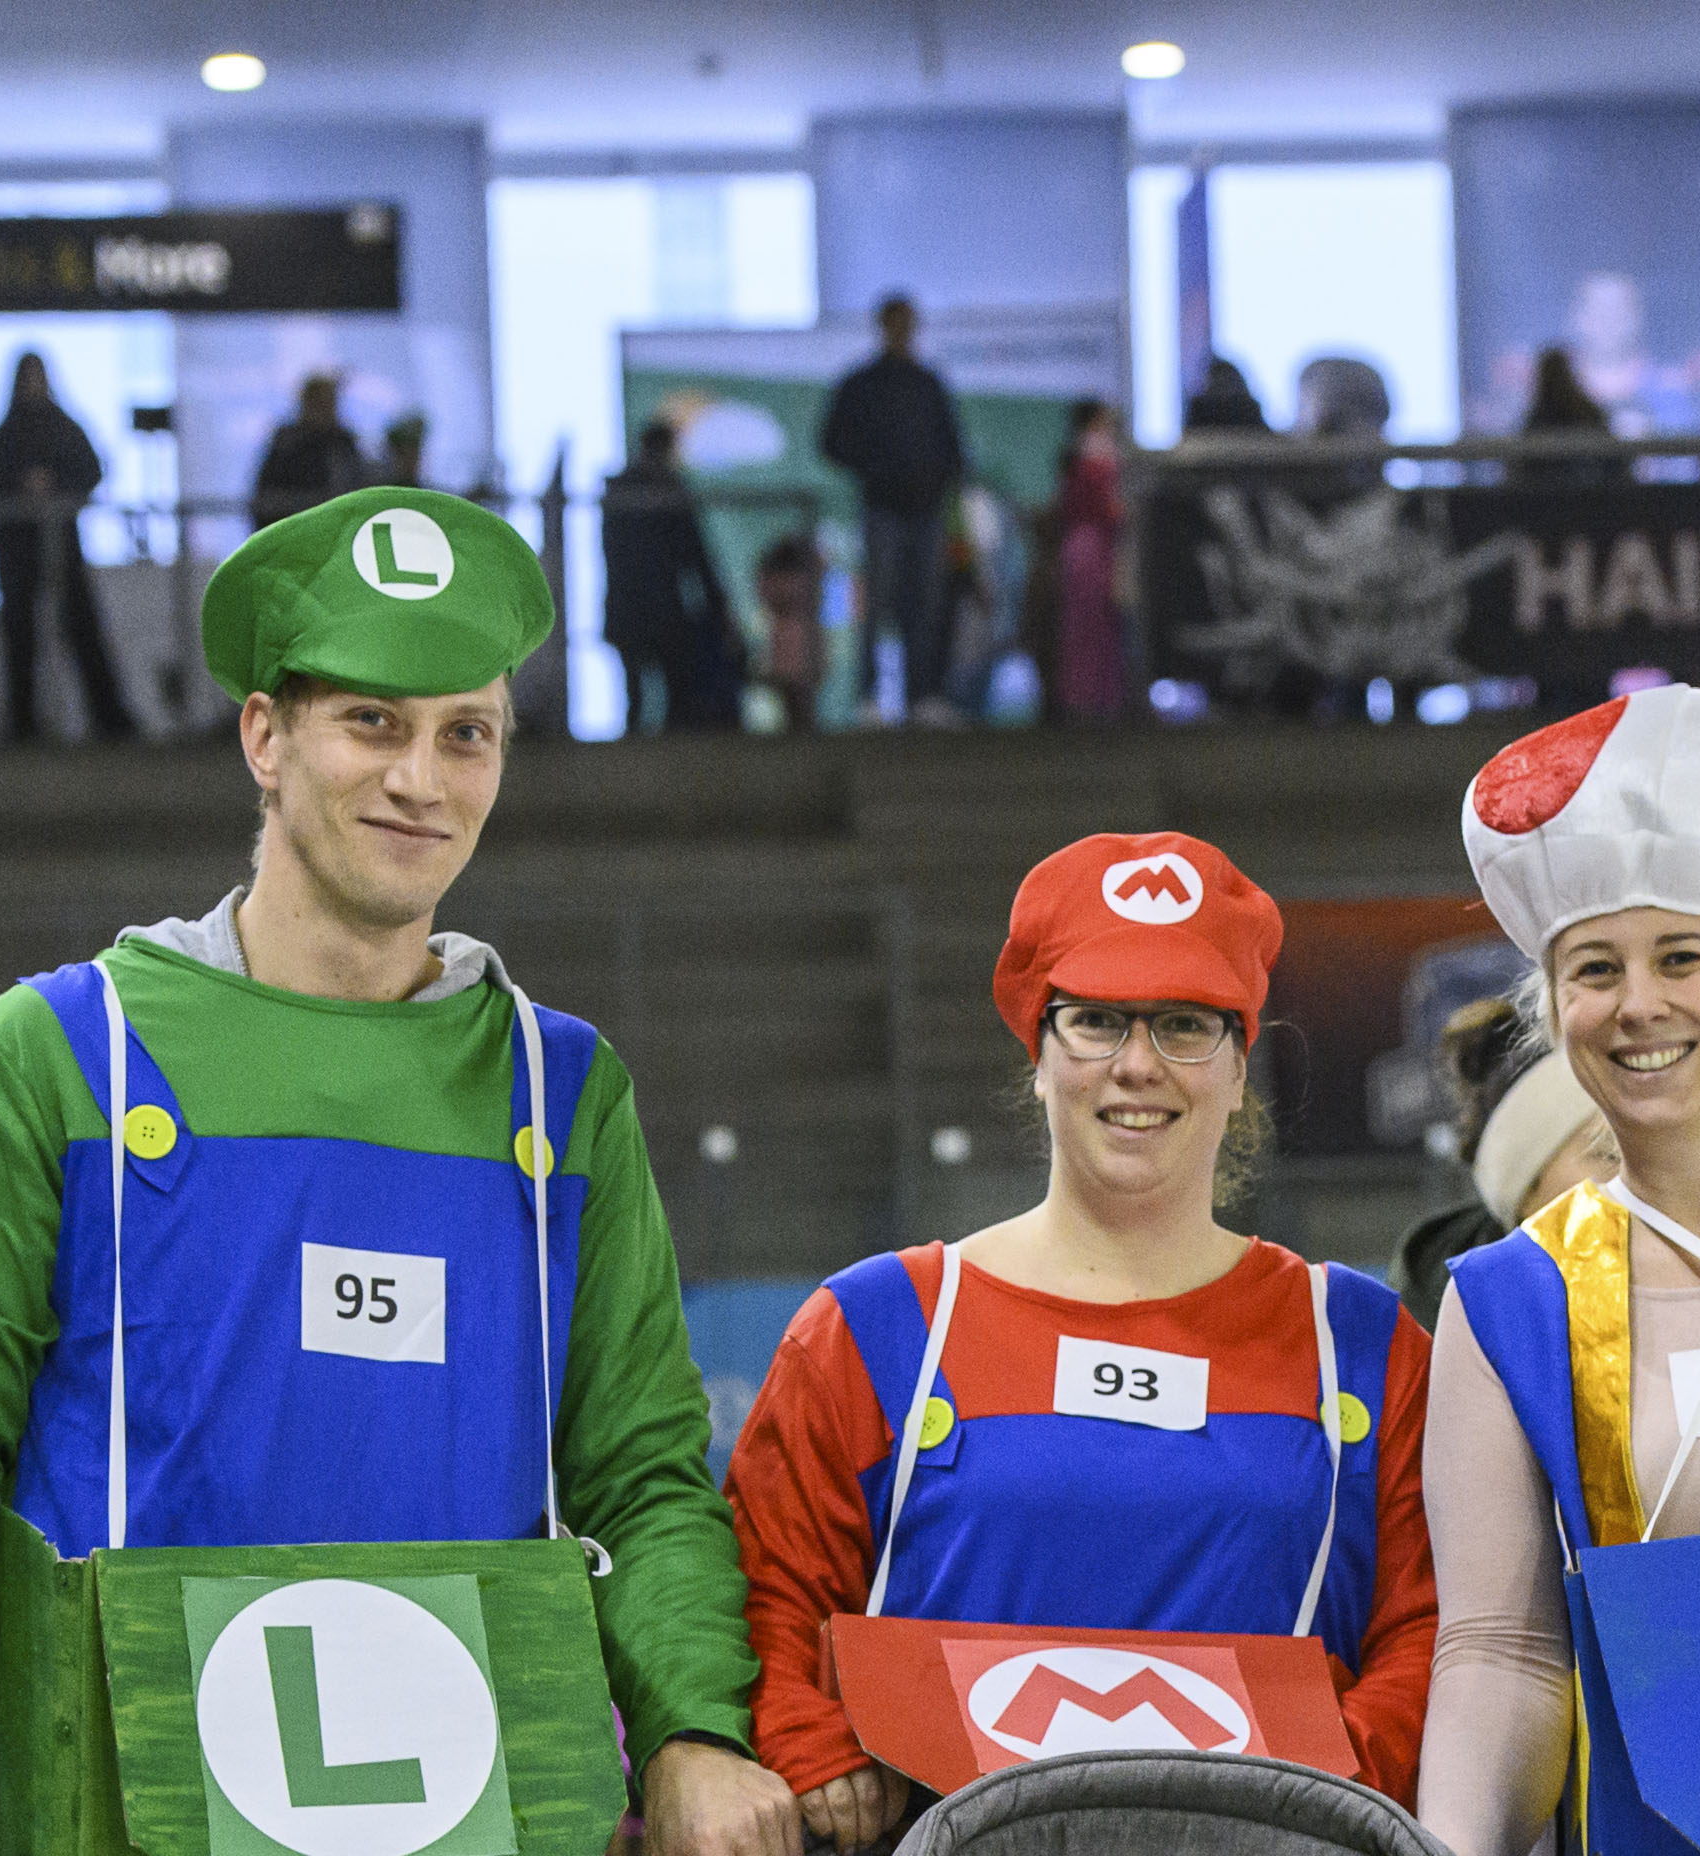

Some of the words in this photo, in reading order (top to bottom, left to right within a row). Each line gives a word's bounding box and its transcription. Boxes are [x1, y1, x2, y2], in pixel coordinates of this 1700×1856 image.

[372, 522, 439, 587] L
[1113, 863, 1192, 904] M
[334, 1273, 398, 1324] 95
[1092, 1362, 1160, 1401] 93
[263, 1625, 427, 1808] L
[991, 1663, 1238, 1751] M
